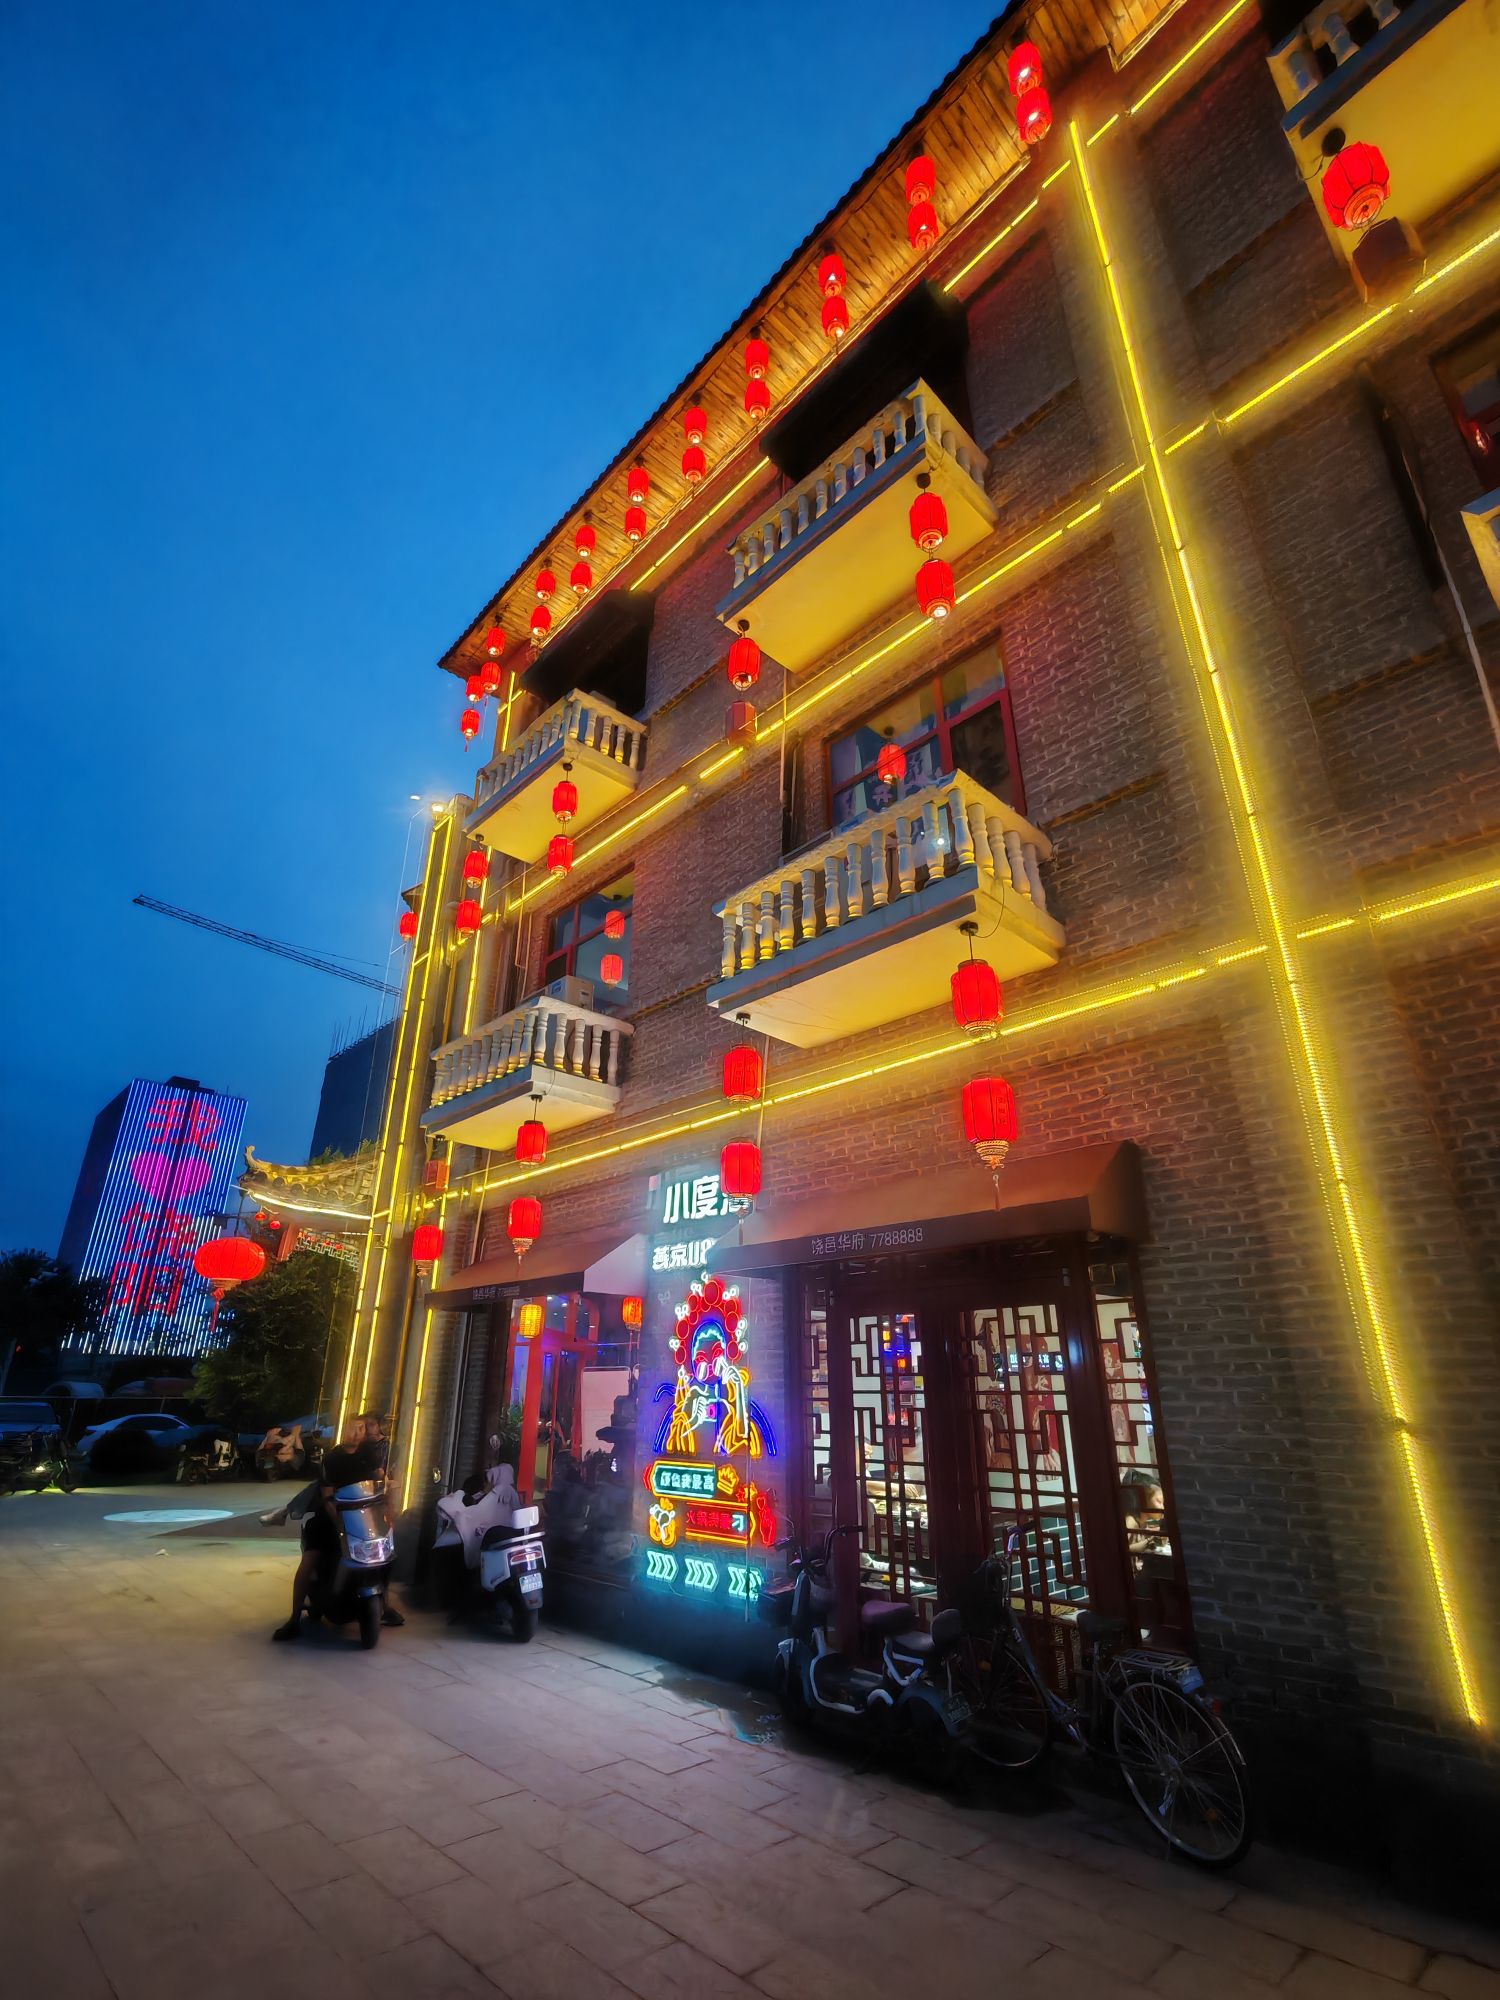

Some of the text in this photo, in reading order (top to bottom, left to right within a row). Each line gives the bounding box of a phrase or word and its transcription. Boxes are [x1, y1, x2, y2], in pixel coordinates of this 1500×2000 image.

[811, 1227, 924, 1256] 饶邑华府 7788888
